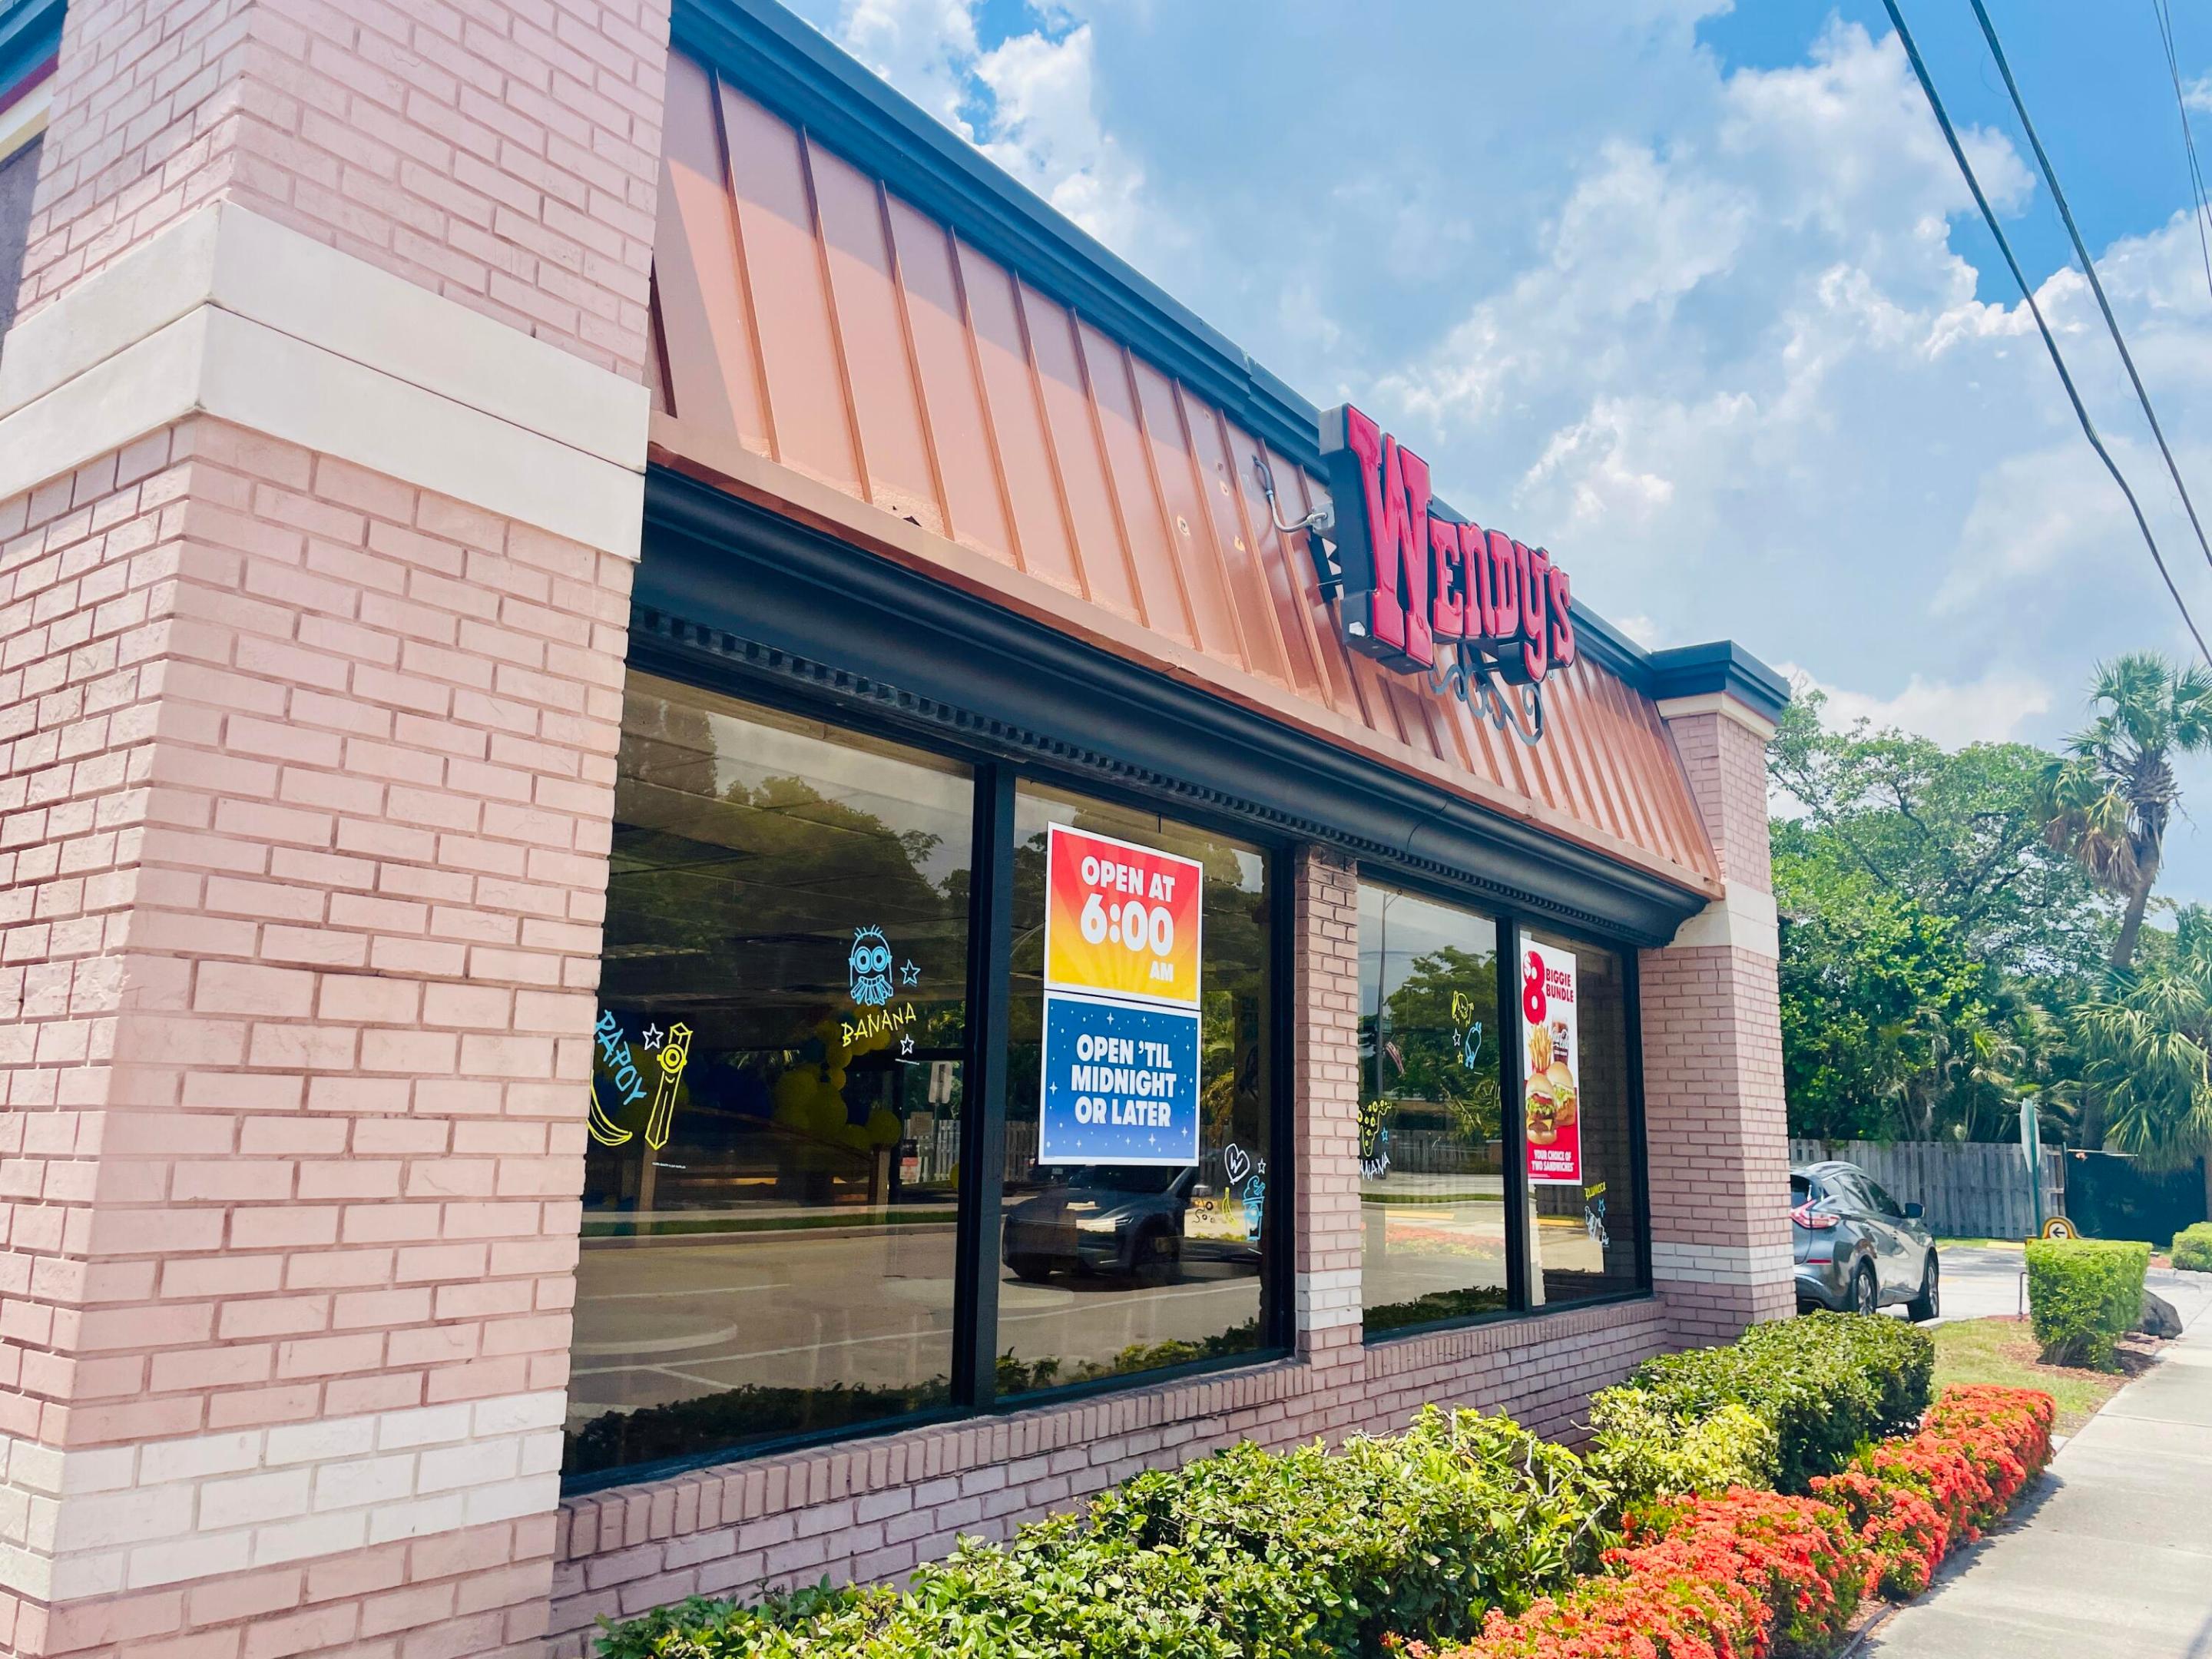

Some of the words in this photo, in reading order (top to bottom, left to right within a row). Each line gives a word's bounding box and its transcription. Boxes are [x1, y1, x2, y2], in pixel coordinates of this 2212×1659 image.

[1081, 856, 1144, 896] OPEN
[1149, 873, 1175, 902] AT
[1081, 892, 1174, 957] 6:00
[1150, 961, 1174, 982] AM
[1545, 968, 1571, 987] BIGGIE
[1546, 984, 1574, 1003] BUNDLE
[841, 1002, 917, 1047] BANANA
[596, 1009, 647, 1106] PAPOY
[1077, 1034, 1134, 1065] OPEN
[1138, 1040, 1172, 1068] 'TIL
[1071, 1065, 1177, 1098] MIDNIGHT
[1075, 1096, 1107, 1124] OR
[1111, 1098, 1171, 1127] LATER
